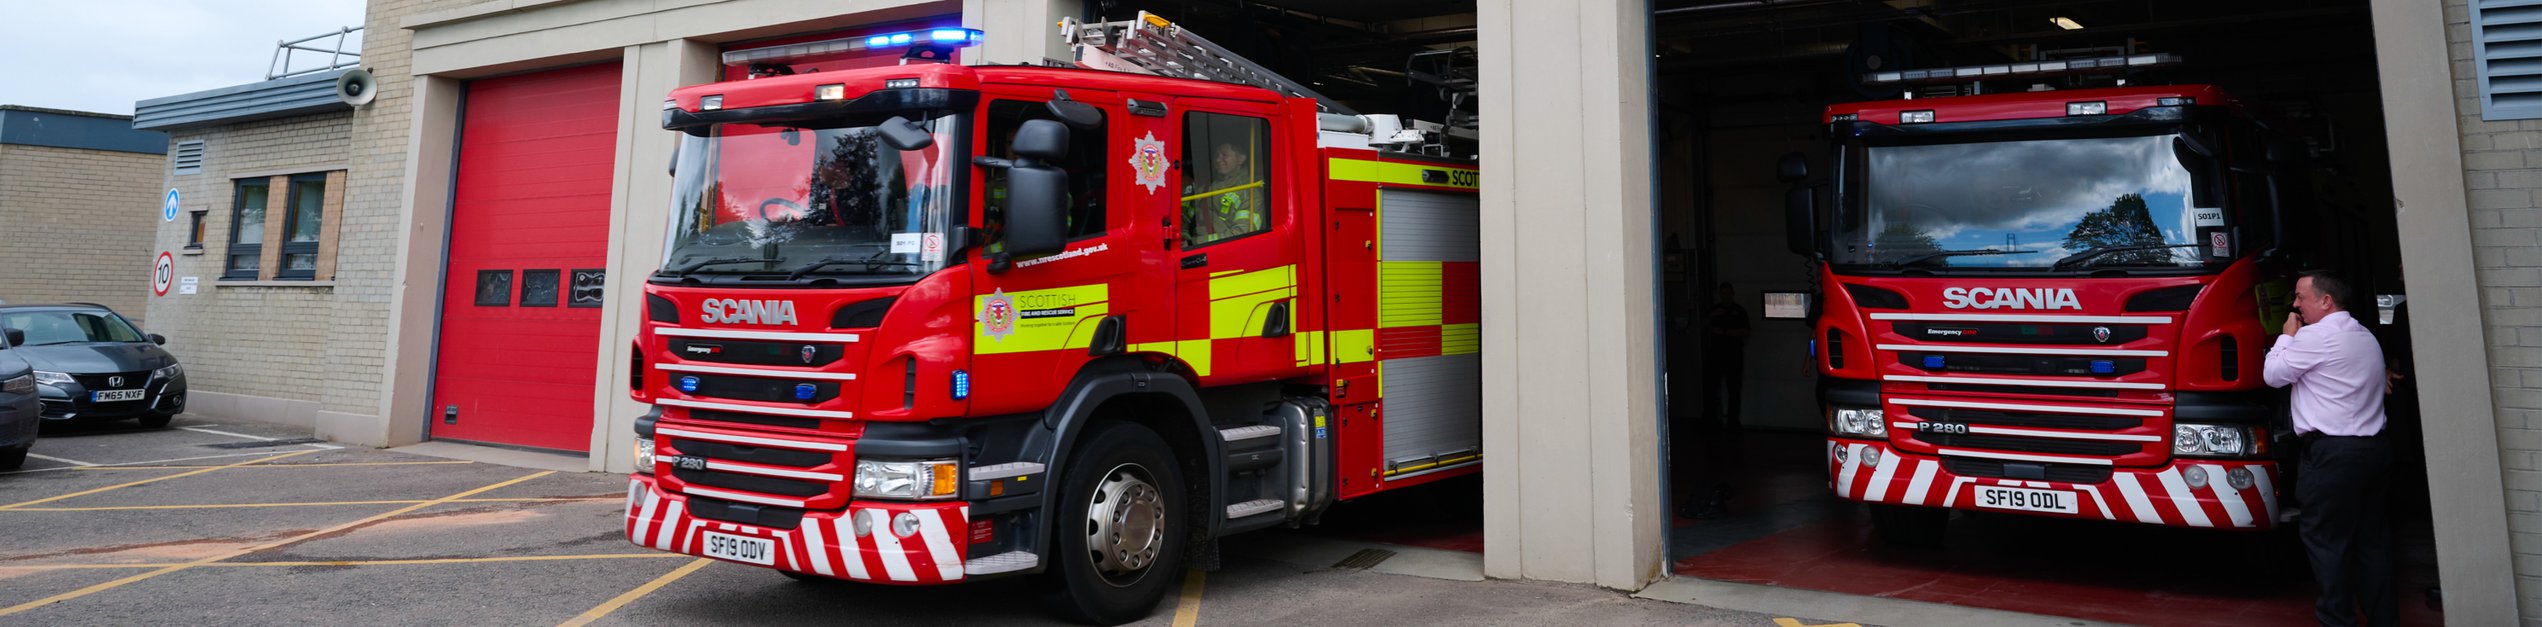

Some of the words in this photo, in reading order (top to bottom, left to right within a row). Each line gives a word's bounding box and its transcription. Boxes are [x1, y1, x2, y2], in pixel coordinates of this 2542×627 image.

[1452, 169, 1480, 187] SCOT
[158, 263, 170, 284] 10
[1020, 293, 1076, 309] SCOTTISH
[1943, 287, 2082, 311] SCANIA
[701, 298, 798, 326] SCANIA
[1927, 328, 1962, 336] Emergency
[97, 391, 123, 400] FM65
[125, 390, 143, 399] NXF
[1919, 422, 1930, 432] P
[1933, 423, 1966, 434] 280
[673, 456, 680, 467] P
[681, 457, 704, 470] 280
[1986, 489, 2025, 507] SF19
[2030, 491, 2066, 510] ODL
[711, 535, 737, 556] SF19
[741, 540, 766, 560] ODV
